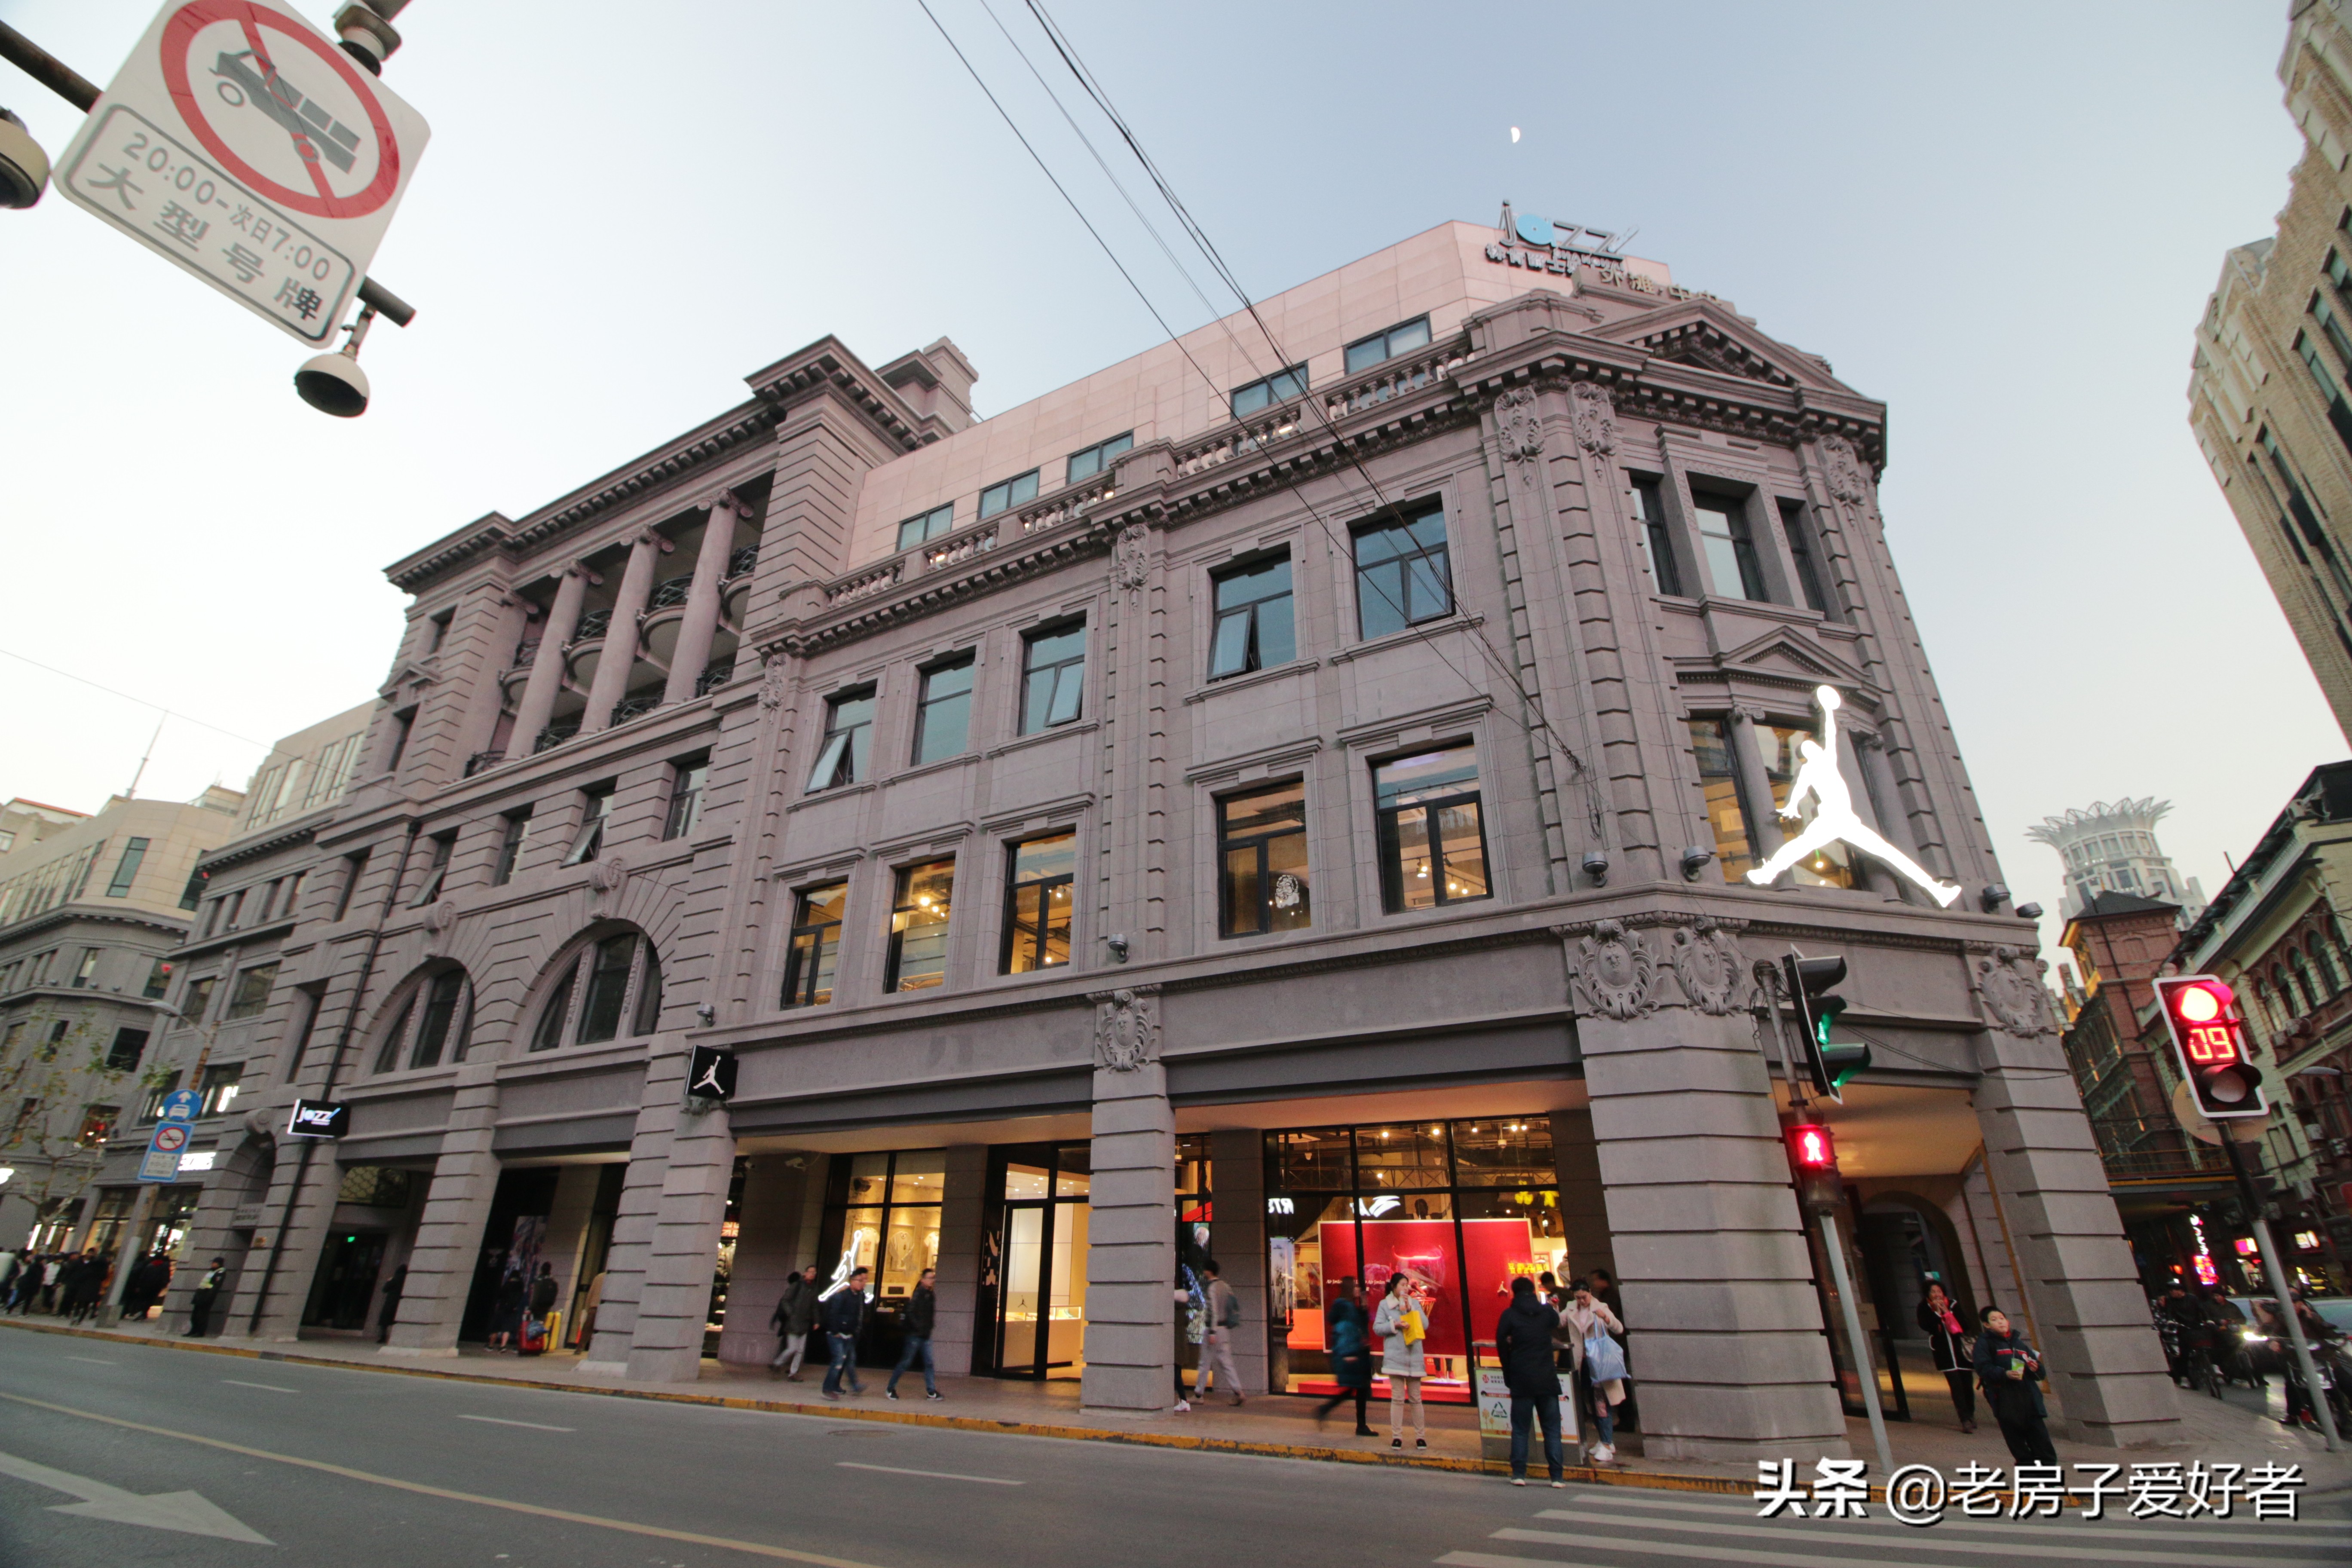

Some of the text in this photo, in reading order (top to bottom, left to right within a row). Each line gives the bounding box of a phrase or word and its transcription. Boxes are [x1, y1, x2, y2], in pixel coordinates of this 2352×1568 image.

[87, 162, 323, 321] 大型号牌
[1499, 199, 1625, 261] jazz
[296, 1107, 334, 1123] jazz
